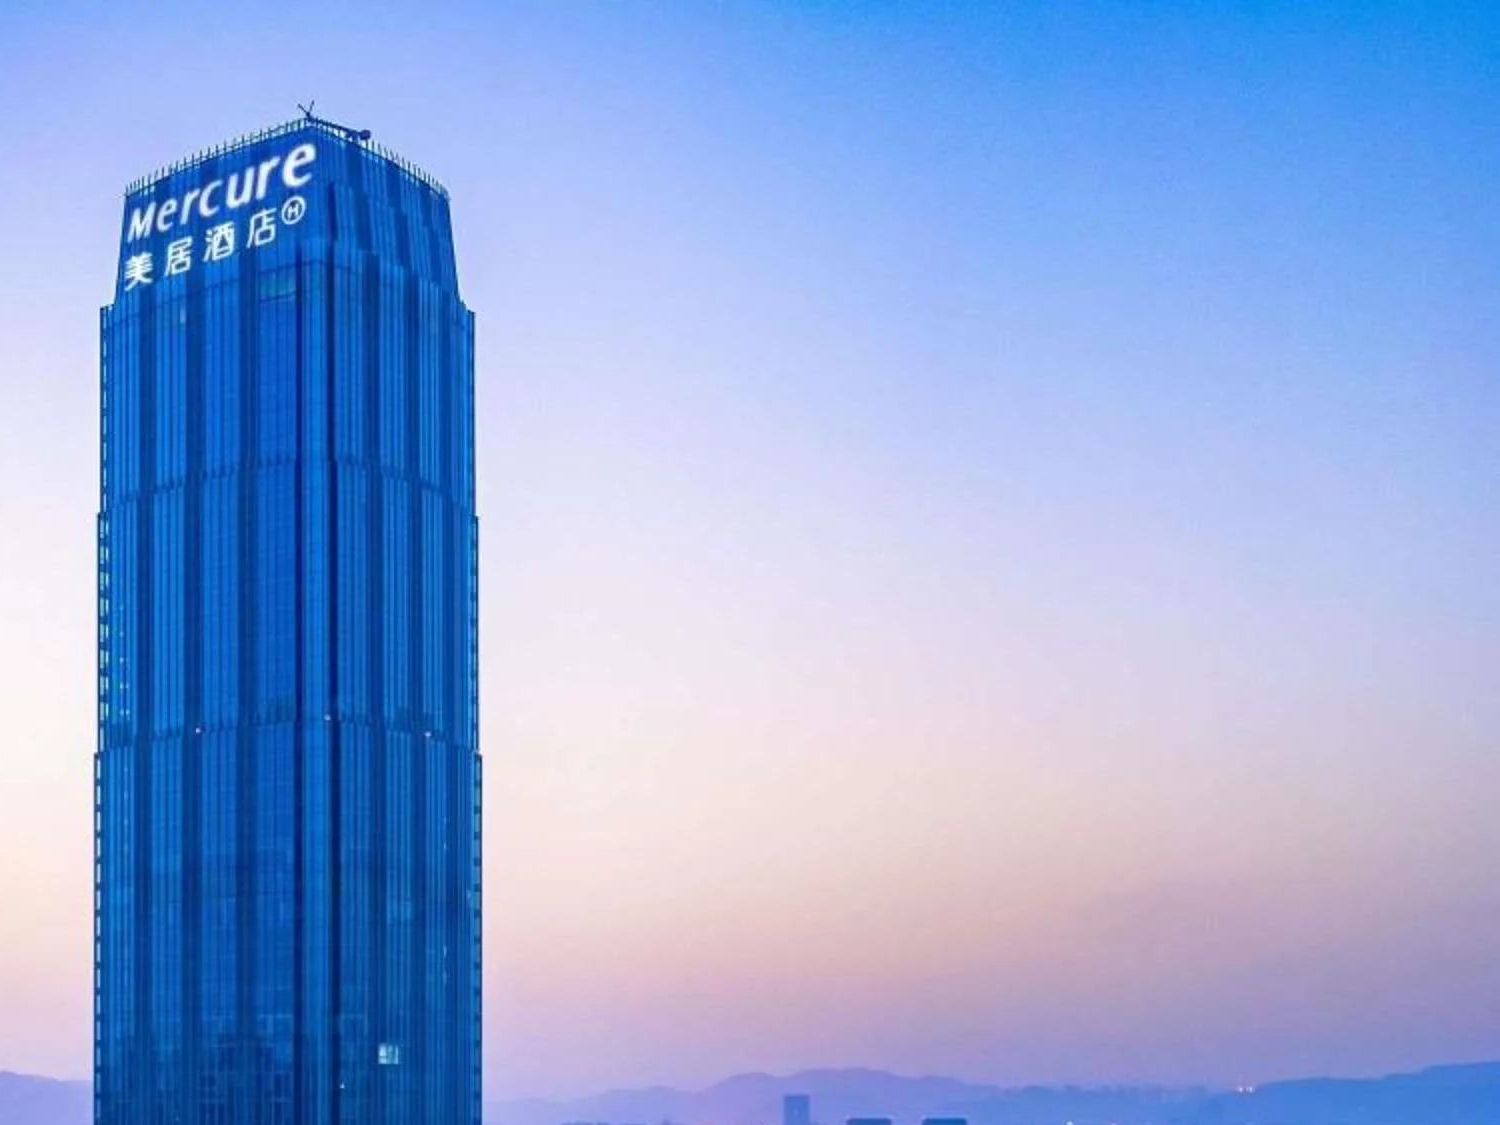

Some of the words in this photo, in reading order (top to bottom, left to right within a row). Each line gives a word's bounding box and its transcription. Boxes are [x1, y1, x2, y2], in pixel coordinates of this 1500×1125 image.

[127, 143, 316, 242] Mercure
[124, 207, 277, 291] 美居酒店
